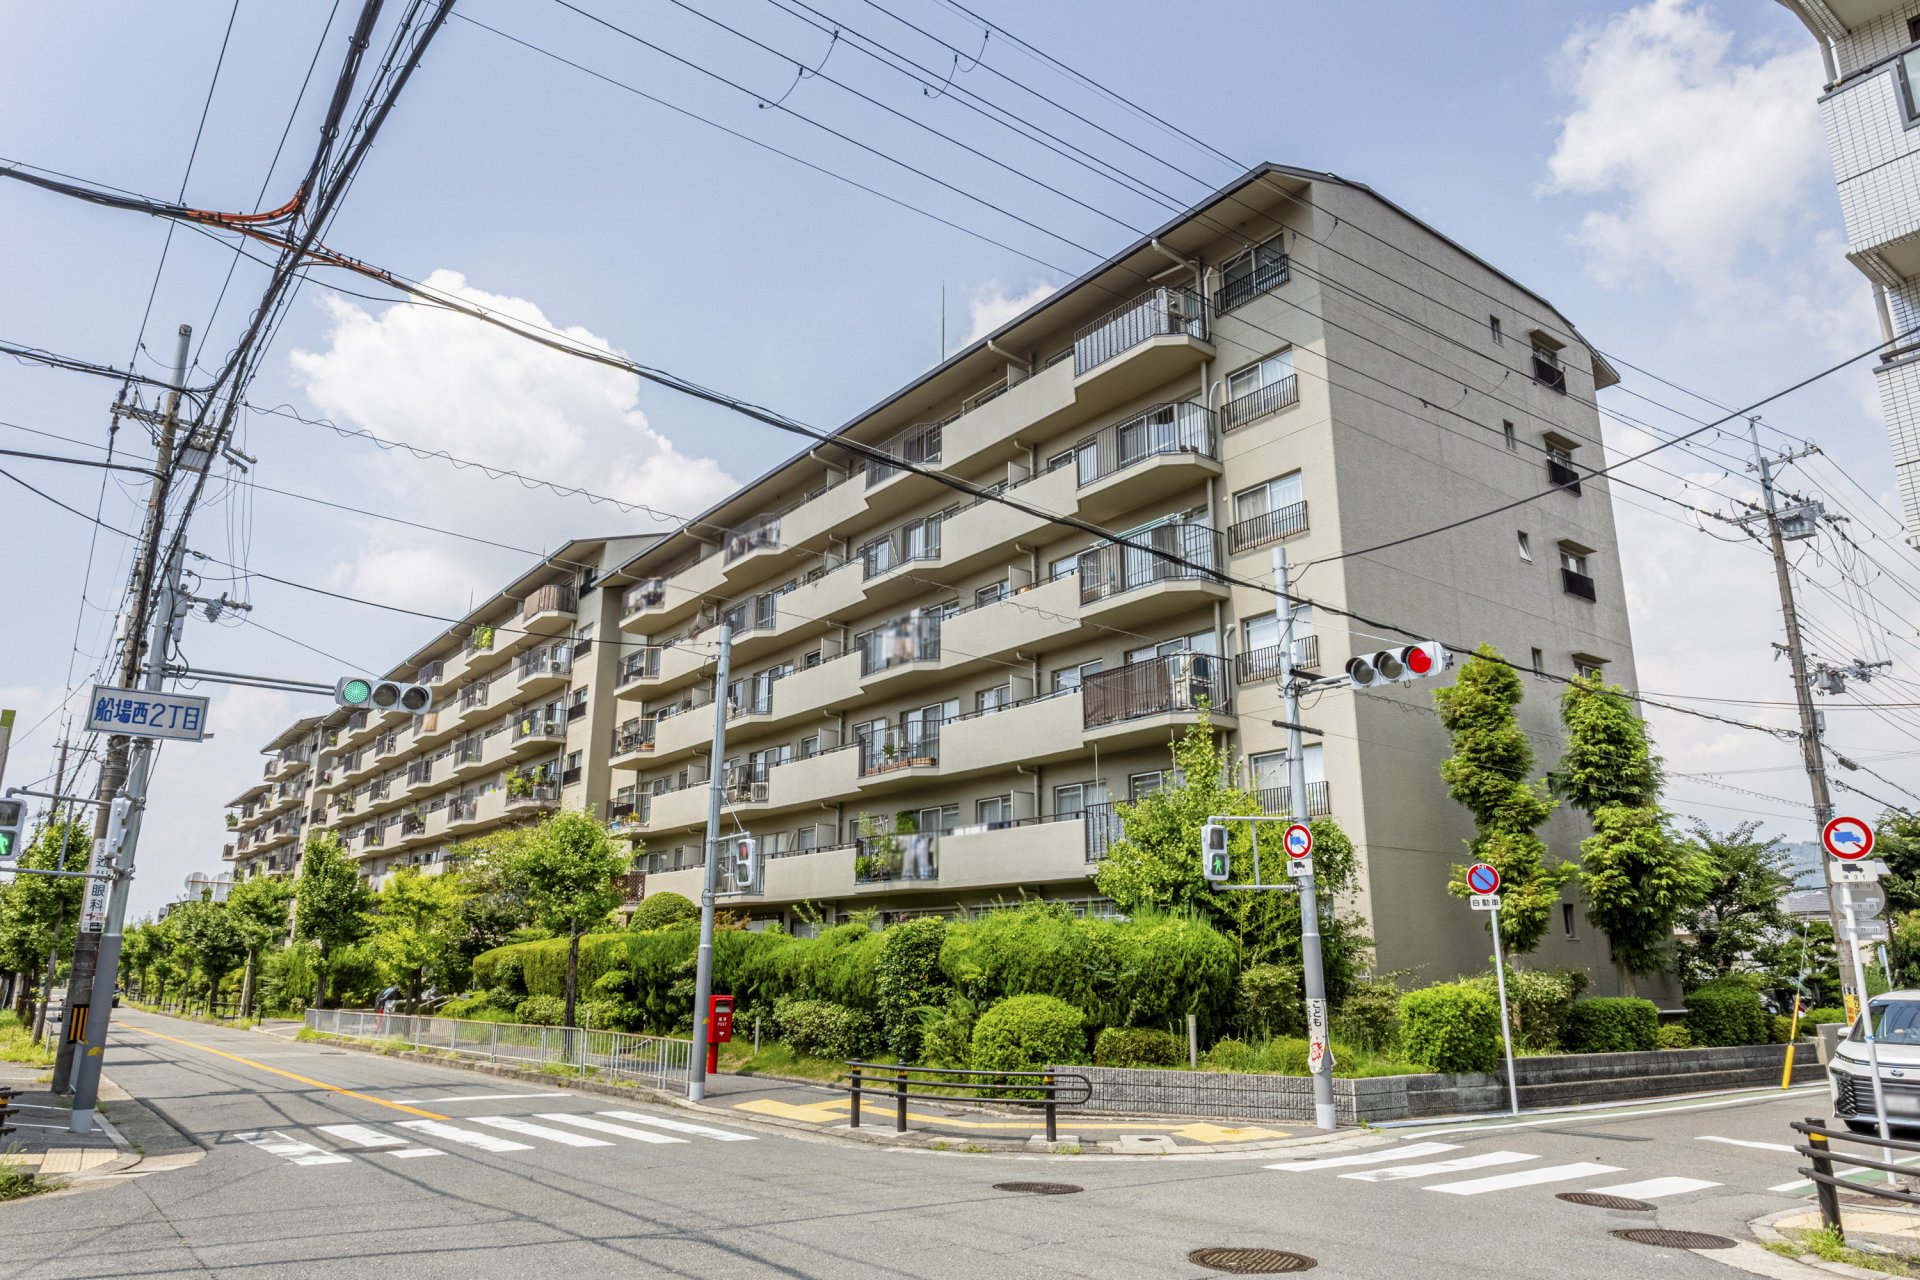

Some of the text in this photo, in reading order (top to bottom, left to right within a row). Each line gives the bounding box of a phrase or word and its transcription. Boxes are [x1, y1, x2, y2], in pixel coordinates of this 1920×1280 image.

[94, 696, 201, 731] 船場西2丁目
[1472, 899, 1500, 907] 自動車
